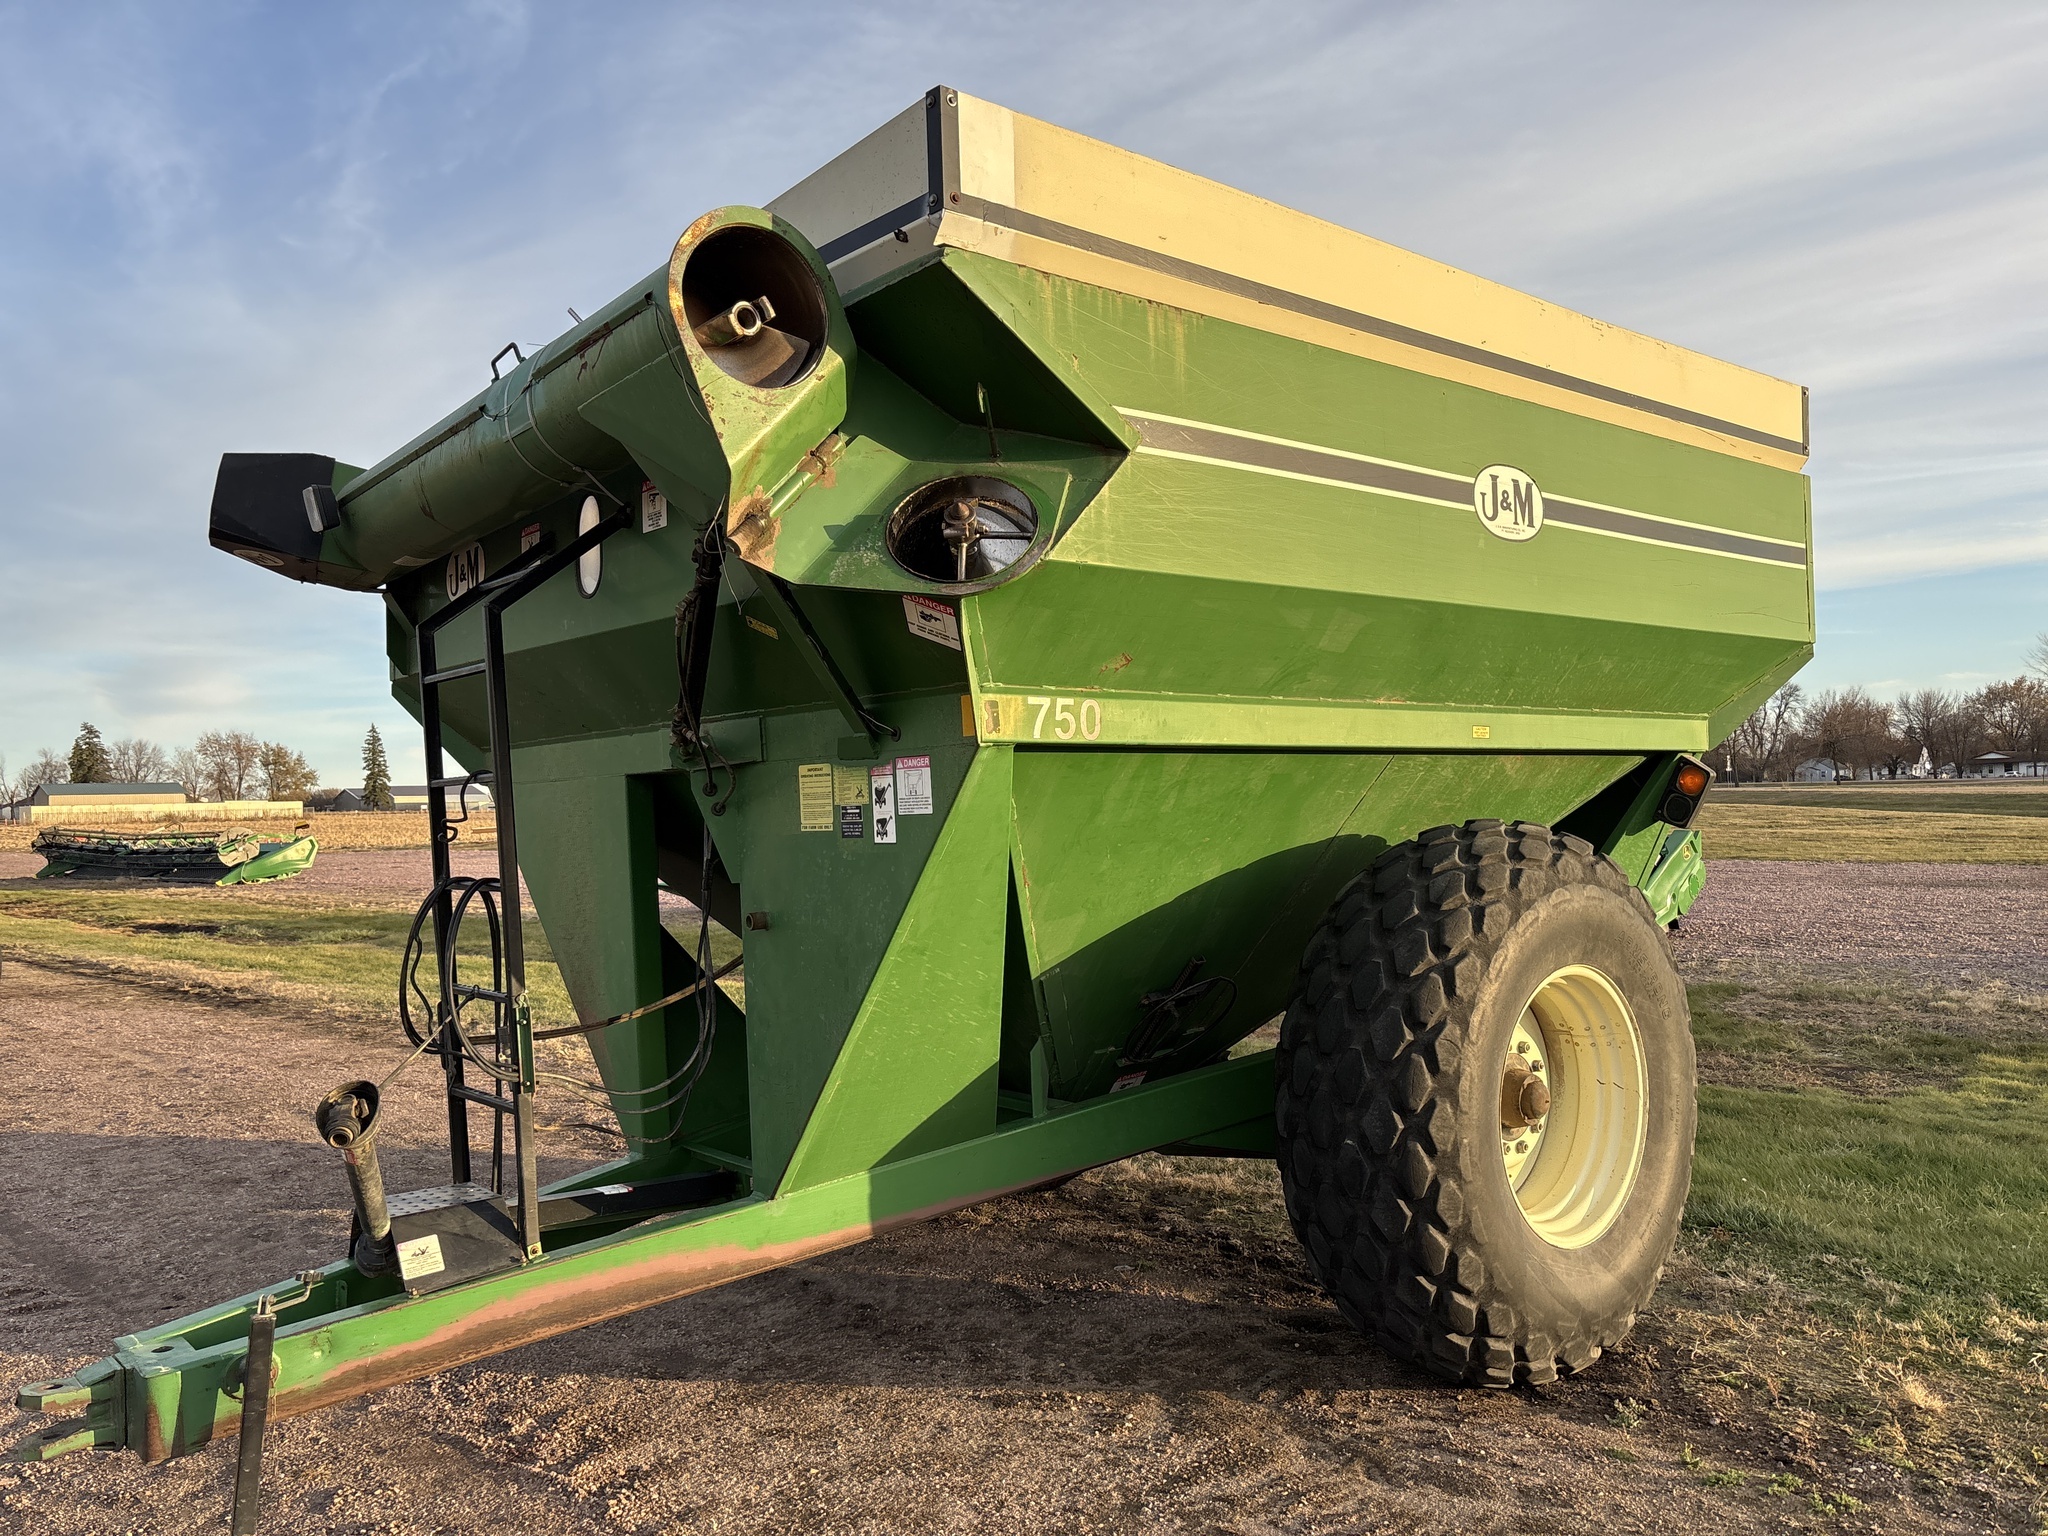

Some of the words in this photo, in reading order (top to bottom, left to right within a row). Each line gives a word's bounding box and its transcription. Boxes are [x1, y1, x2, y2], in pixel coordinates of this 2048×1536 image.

[1480, 474, 1535, 528] J&M
[449, 546, 480, 597] J&M
[912, 595, 954, 616] DANGER
[1027, 696, 1101, 740] 750
[903, 757, 930, 767] DANGER
